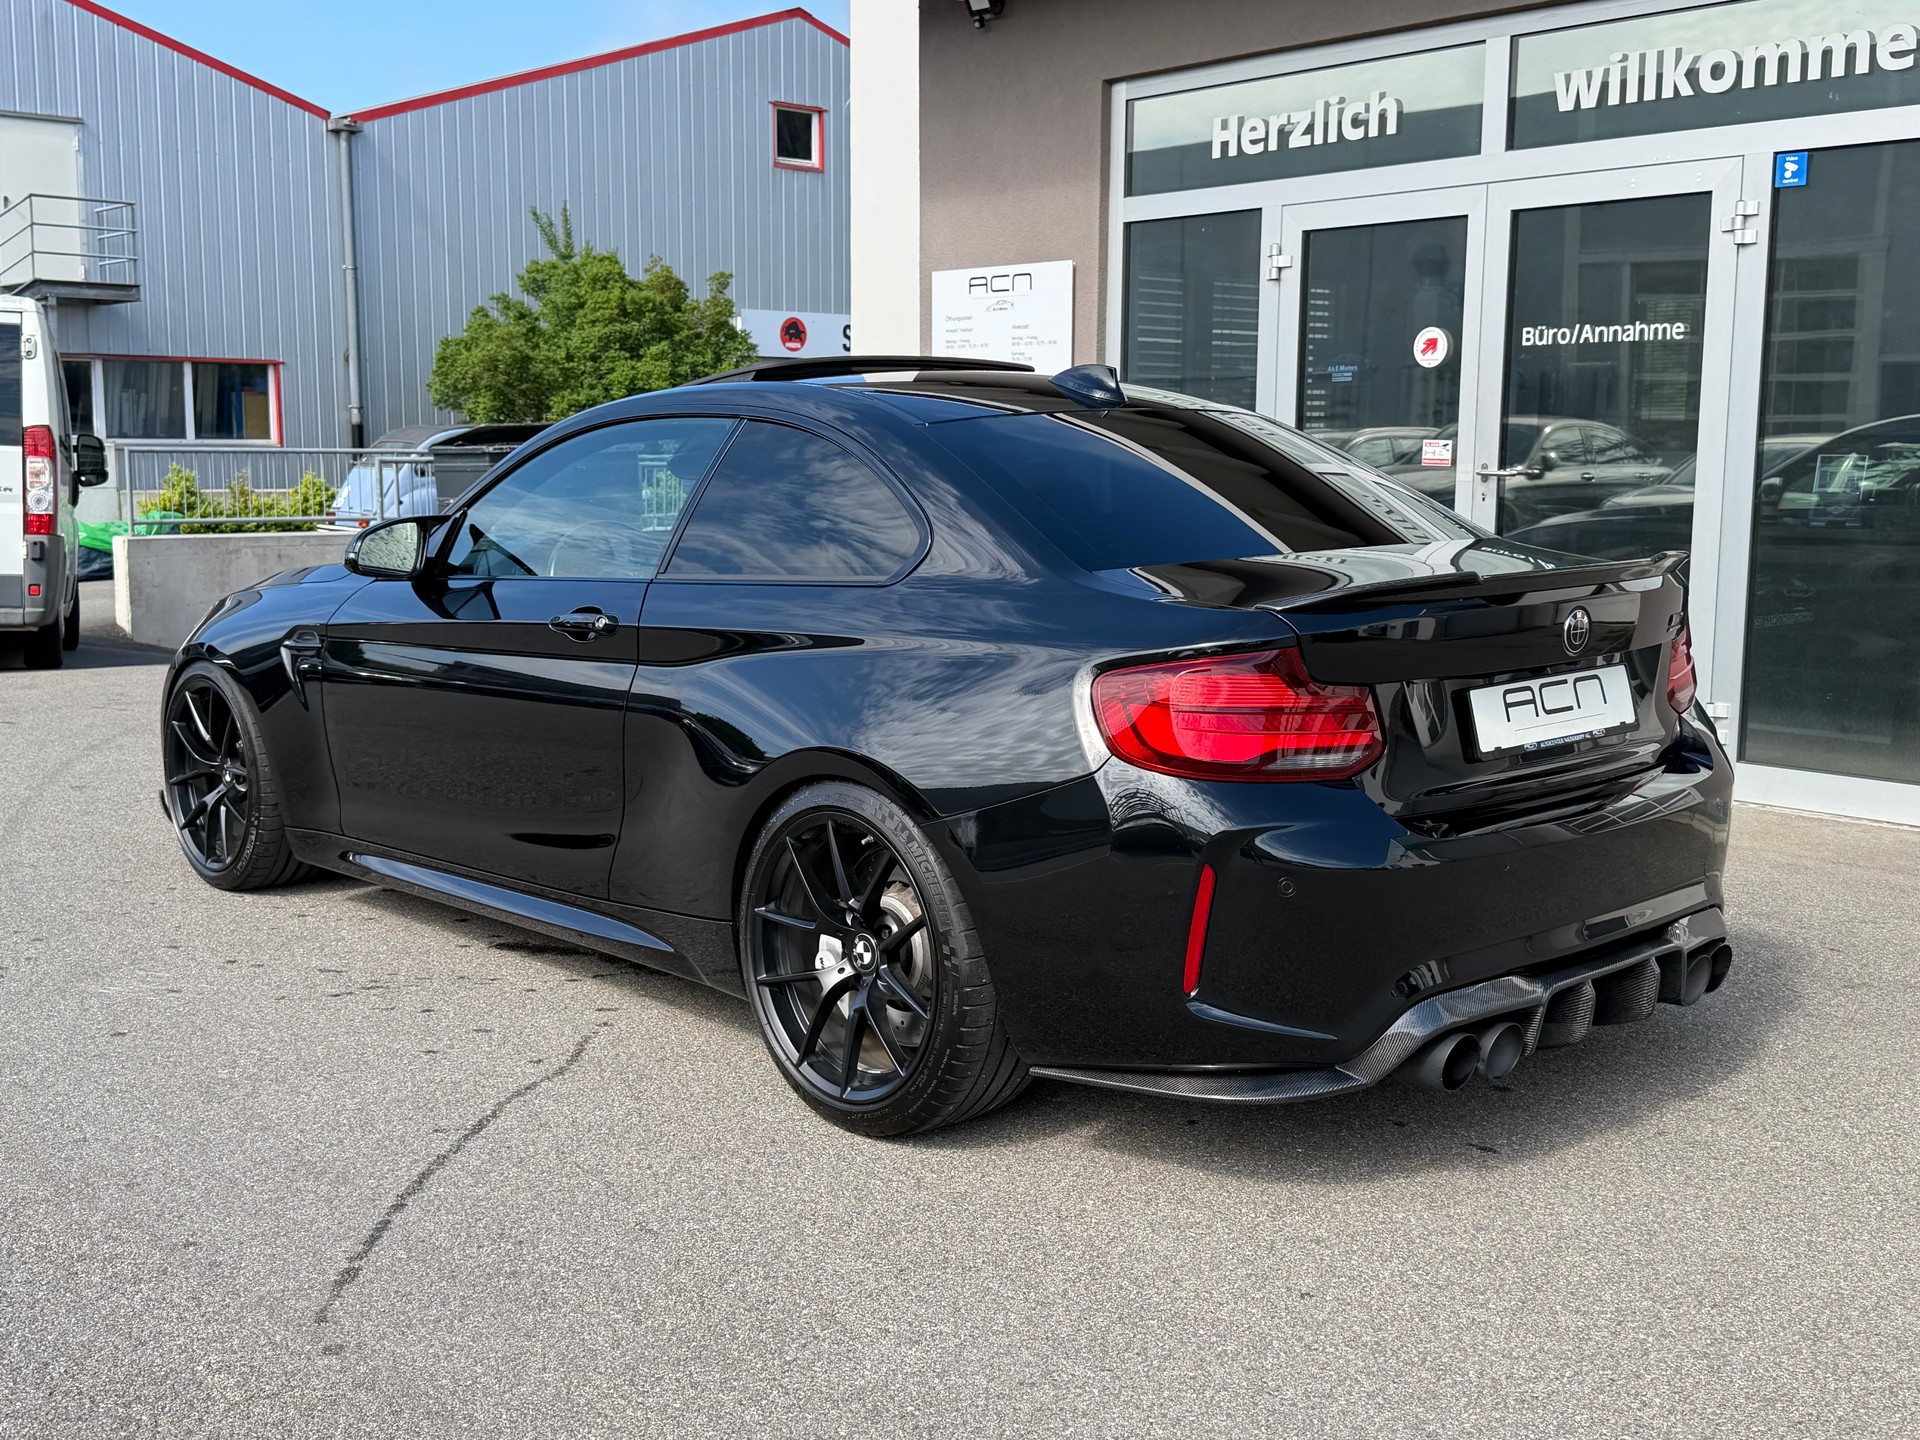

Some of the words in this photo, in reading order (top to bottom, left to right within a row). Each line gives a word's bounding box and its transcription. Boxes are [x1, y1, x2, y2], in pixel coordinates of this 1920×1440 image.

[1211, 90, 1397, 160] Herzlich
[968, 273, 1033, 294] ACN
[1521, 321, 1685, 346] Büro/Annahme
[1502, 674, 1608, 722] ACN
[907, 840, 953, 930] MICHELIN
